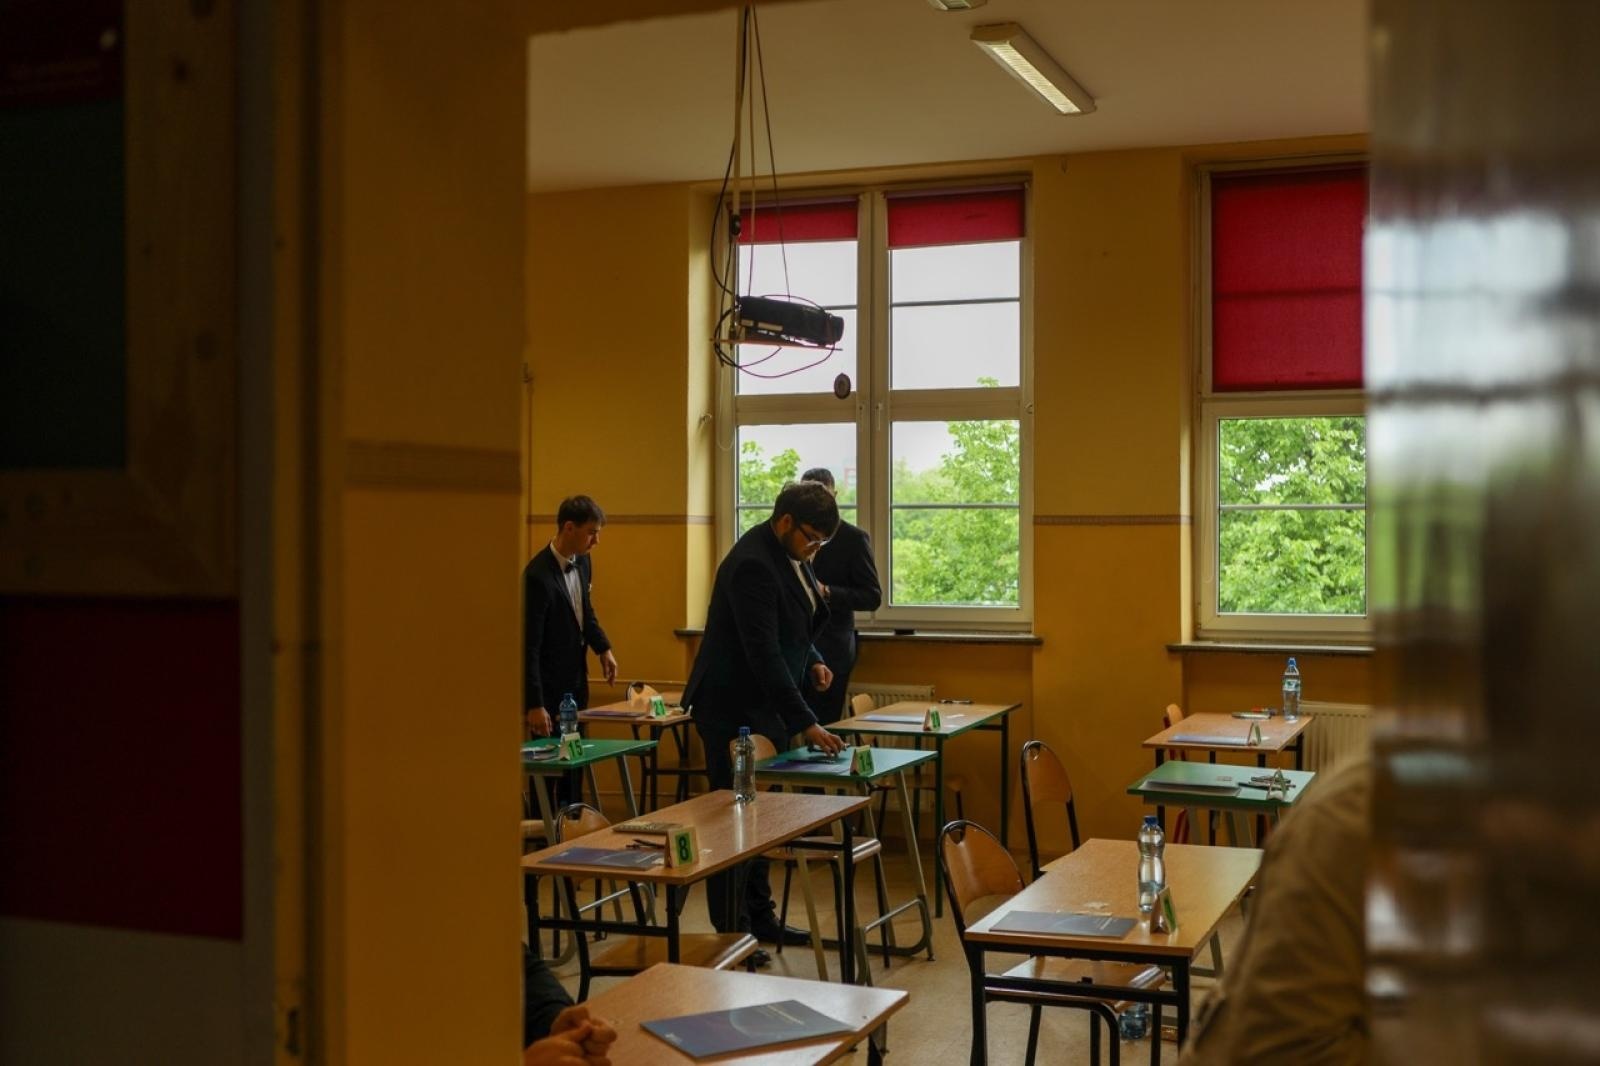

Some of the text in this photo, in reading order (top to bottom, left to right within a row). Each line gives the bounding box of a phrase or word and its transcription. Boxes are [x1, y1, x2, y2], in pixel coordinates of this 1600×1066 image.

[568, 739, 583, 757] 15
[859, 750, 873, 771] 14
[678, 835, 689, 861] 8
